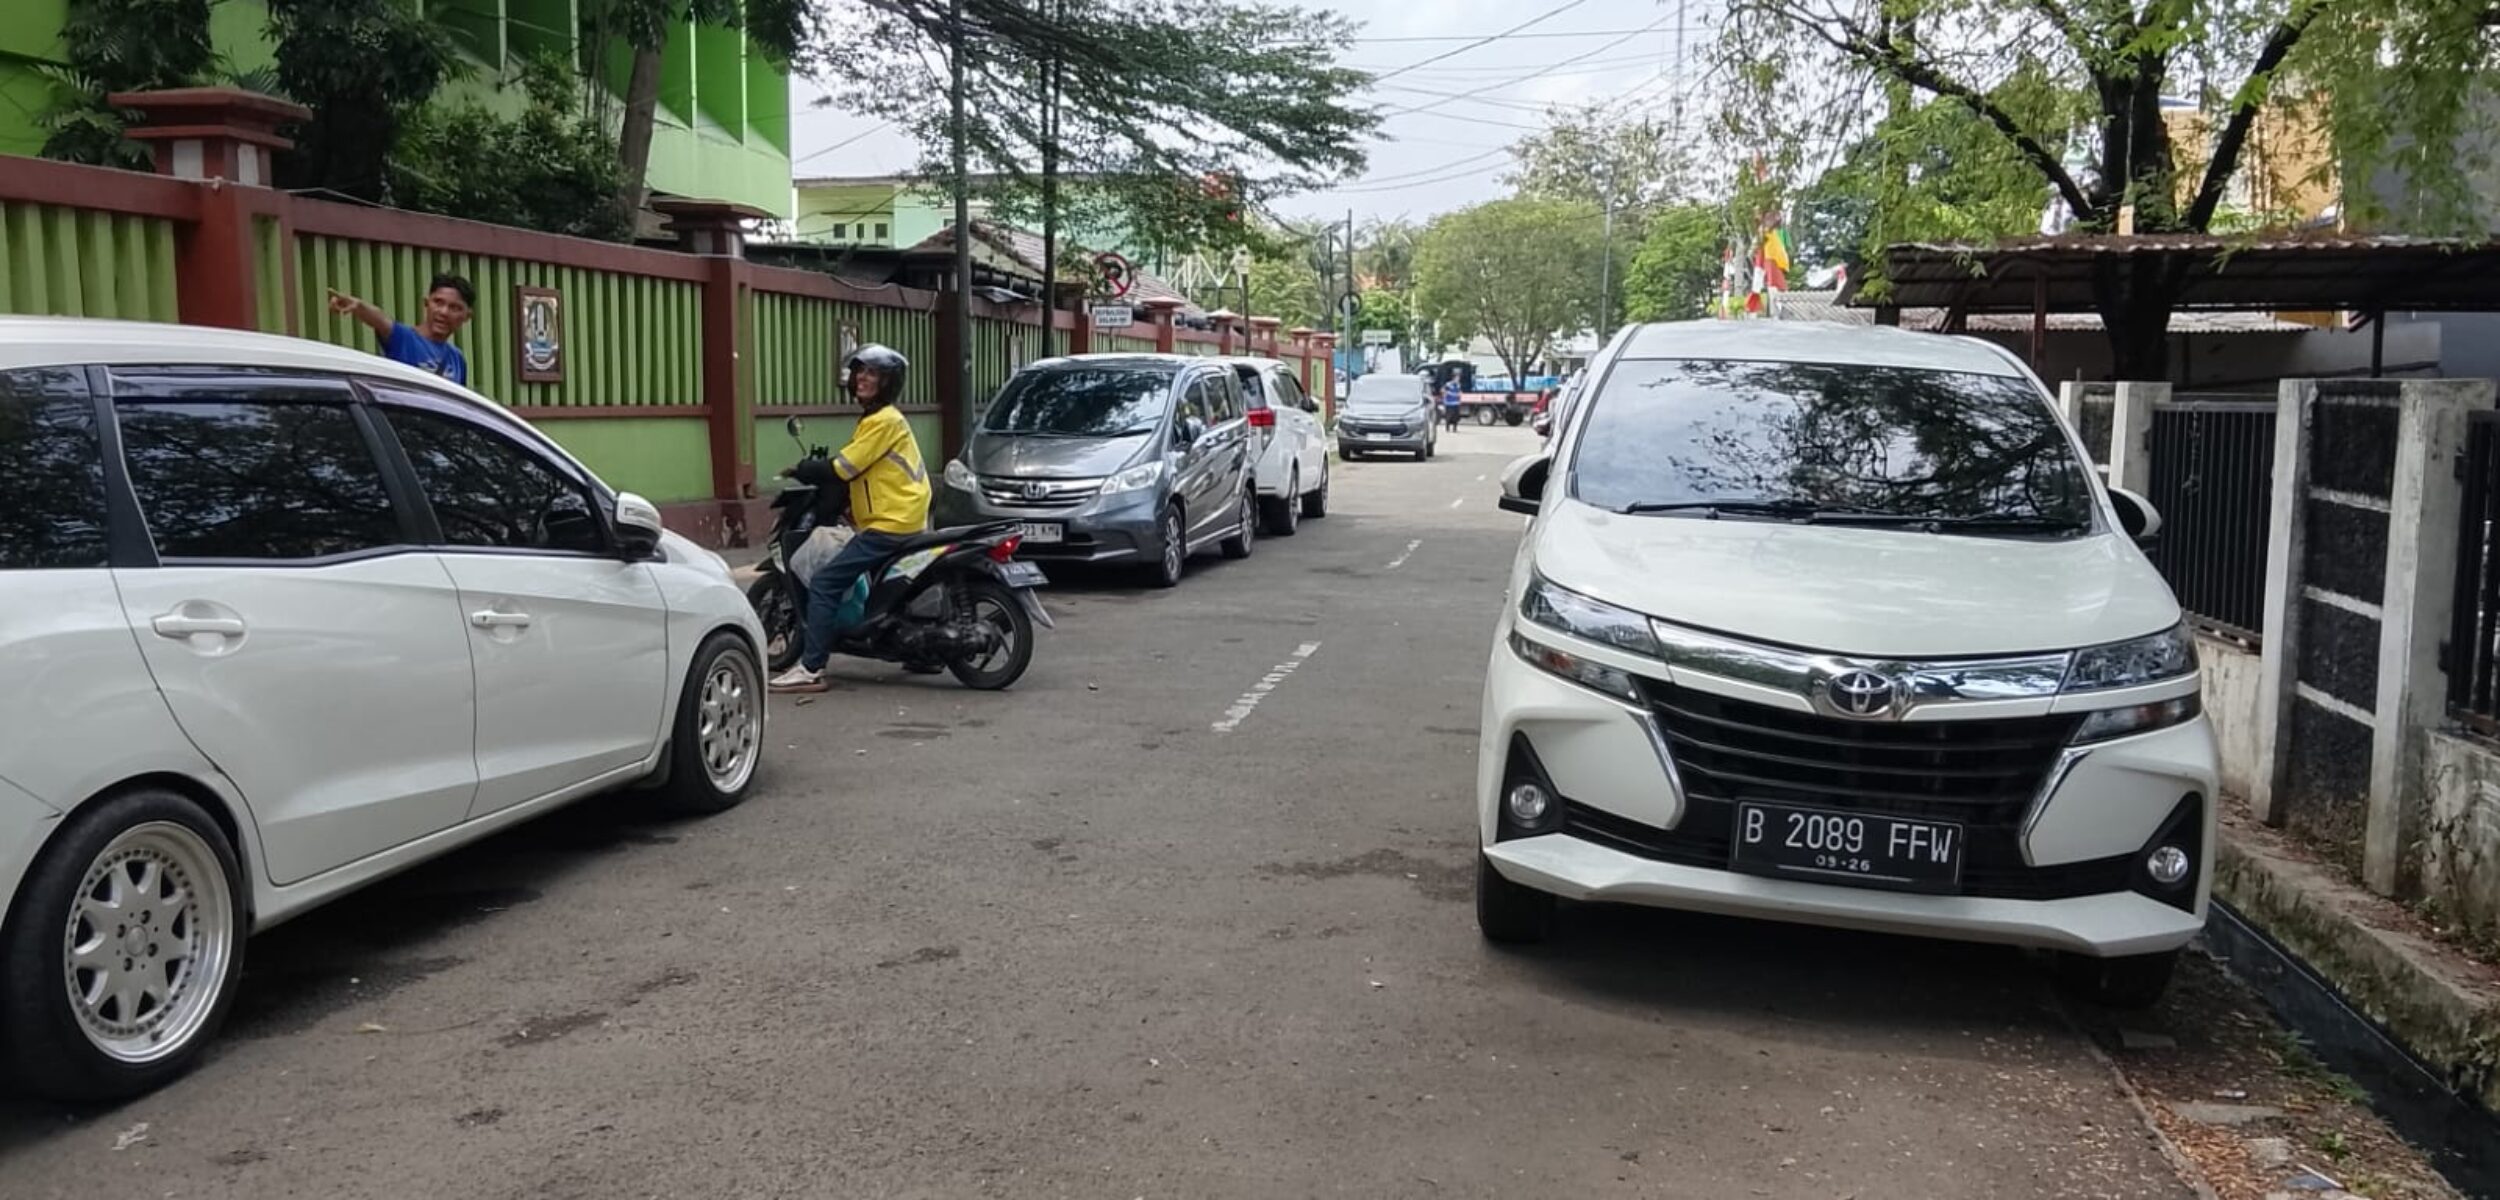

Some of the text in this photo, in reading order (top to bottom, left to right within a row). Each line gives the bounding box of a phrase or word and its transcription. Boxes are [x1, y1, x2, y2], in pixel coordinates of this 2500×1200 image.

[1745, 808, 1952, 863] B 2089 FFW
